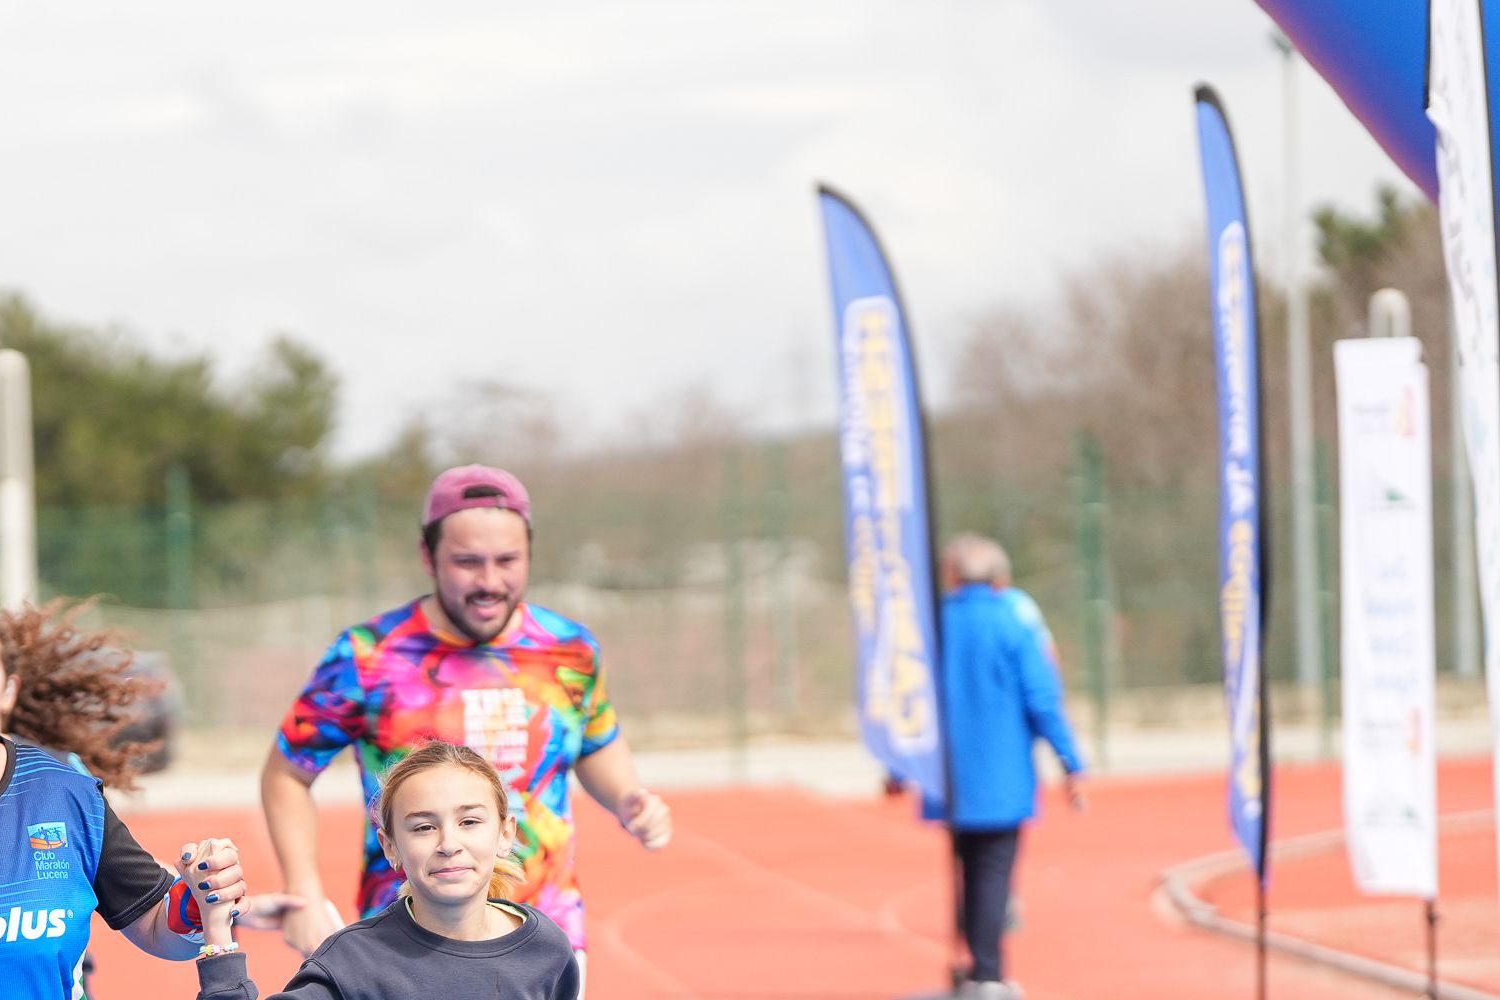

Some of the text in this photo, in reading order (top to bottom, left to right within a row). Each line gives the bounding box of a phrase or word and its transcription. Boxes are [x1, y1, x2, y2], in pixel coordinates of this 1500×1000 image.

[33, 850, 55, 861] Club
[35, 859, 70, 870] Maratón
[37, 871, 69, 880] Lucena
